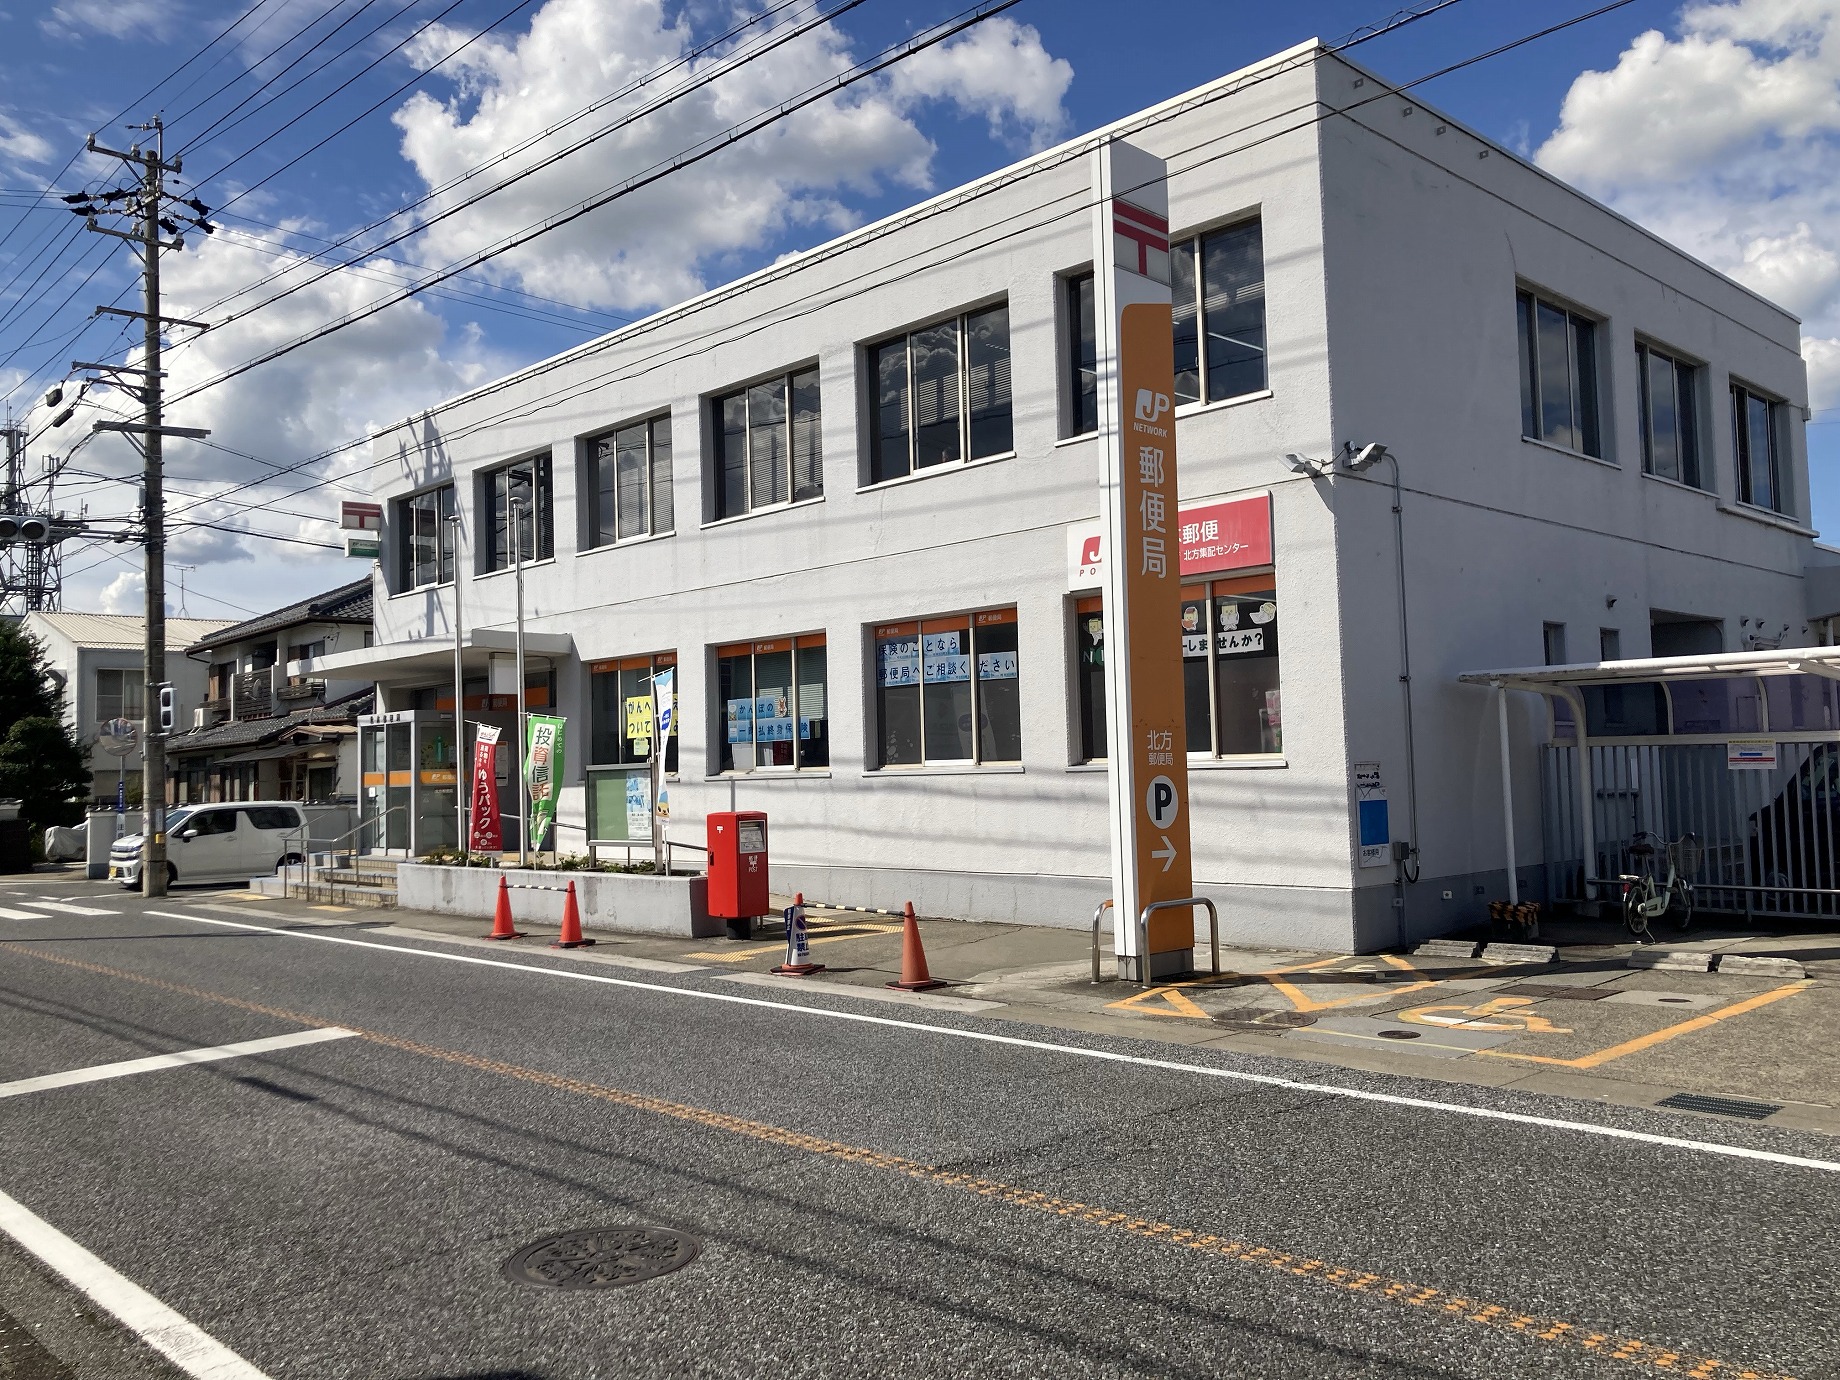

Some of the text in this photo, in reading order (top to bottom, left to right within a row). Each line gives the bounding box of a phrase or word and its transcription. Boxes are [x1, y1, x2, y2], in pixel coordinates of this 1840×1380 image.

[1133, 422, 1168, 439] NETWORK
[1138, 445, 1168, 579] 郵便局
[1183, 543, 1249, 561] 北方集配センター
[878, 635, 958, 657] 保険のことなら
[878, 658, 1016, 681] 郵便局へご相談ください
[1146, 729, 1173, 752] 北方
[532, 727, 552, 801] 投資信託
[1148, 752, 1174, 767] 郵便局
[477, 769, 491, 830] ゆうパック
[1155, 783, 1173, 821] P
